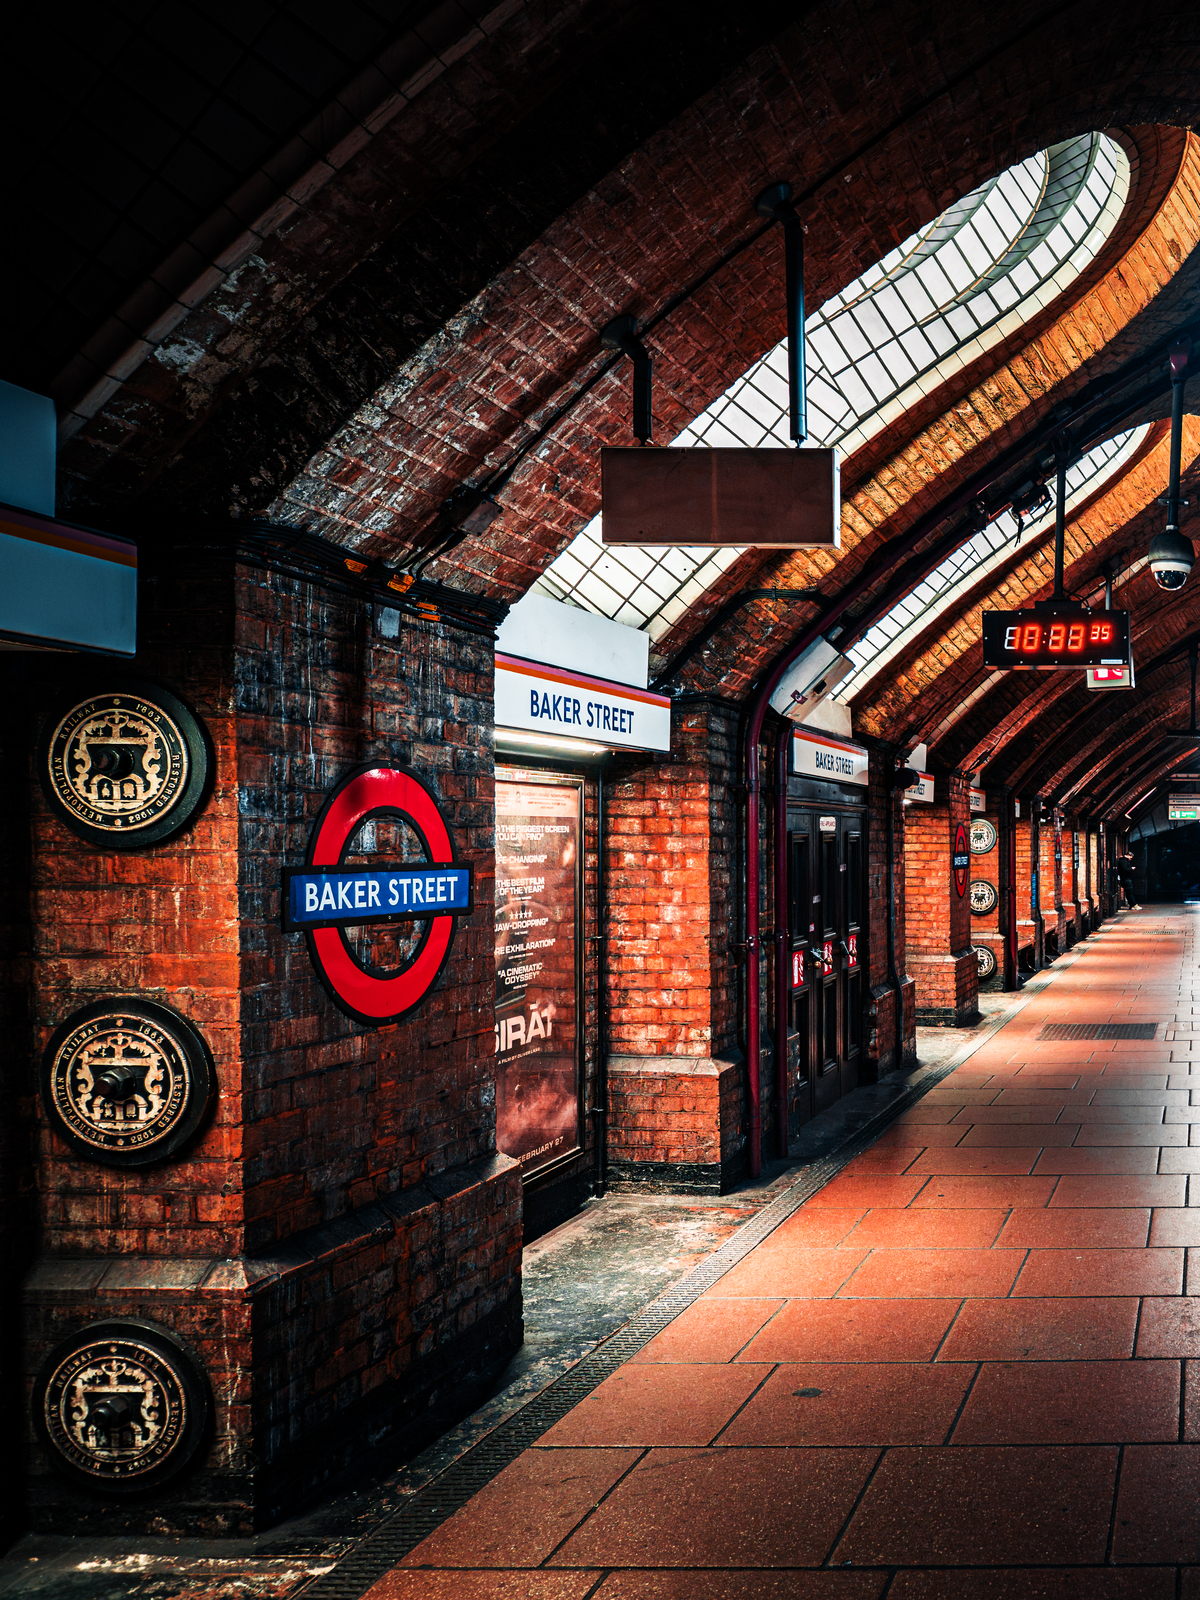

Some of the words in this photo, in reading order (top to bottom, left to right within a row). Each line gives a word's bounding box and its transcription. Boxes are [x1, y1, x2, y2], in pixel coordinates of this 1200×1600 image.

[1091, 624, 1112, 640] 35
[530, 689, 581, 725] BAKER
[586, 701, 634, 734] STREET
[60, 703, 97, 740] RAILWAY
[157, 754, 181, 807] RESTORED
[816, 751, 834, 771] BAKER
[836, 758, 854, 776] STREET
[306, 880, 381, 912] BAKER
[388, 877, 458, 906] STREET
[500, 887, 509, 895] OF
[510, 887, 523, 895] THE
[511, 878, 529, 887] BEST
[530, 877, 545, 885] FILM
[506, 963, 542, 976] CINEMATIC
[62, 1024, 100, 1060] RAILWAY
[139, 1024, 165, 1044] 1863
[57, 1077, 106, 1142] METROPOLITAN
[158, 1075, 182, 1128] RESTORED
[554, 1136, 563, 1146] 27
[56, 1351, 93, 1388] RAILWAY
[155, 1402, 180, 1455] RESTORED
